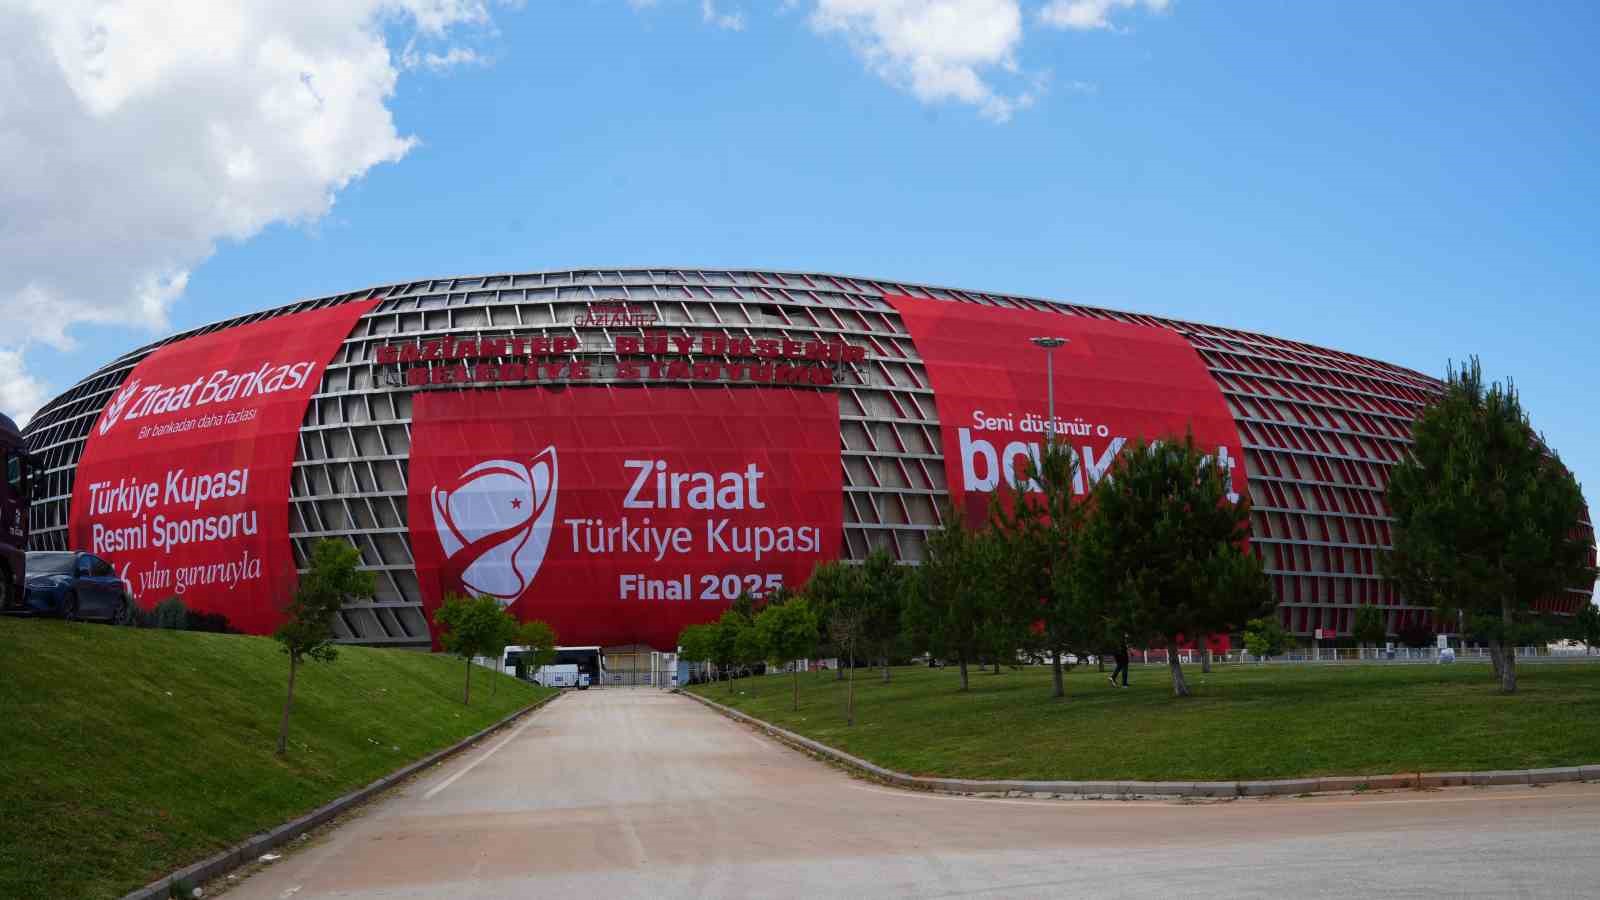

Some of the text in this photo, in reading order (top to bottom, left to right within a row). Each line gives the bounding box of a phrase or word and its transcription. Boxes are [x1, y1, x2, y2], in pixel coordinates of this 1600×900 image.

[124, 361, 316, 420] Ziraat Bankası
[138, 407, 257, 440] Bir bankadan daha fazlası
[972, 409, 1014, 431] Seni
[1096, 423, 1109, 438] o
[88, 469, 249, 519] Türkiye Kupası
[623, 459, 766, 510] Ziraat
[93, 509, 258, 553] Resmi Sponsoru
[564, 517, 821, 561] Türkiye Kupası
[139, 561, 171, 598] yılın
[174, 551, 261, 595] gururuyla
[619, 573, 784, 600] Final 2025
